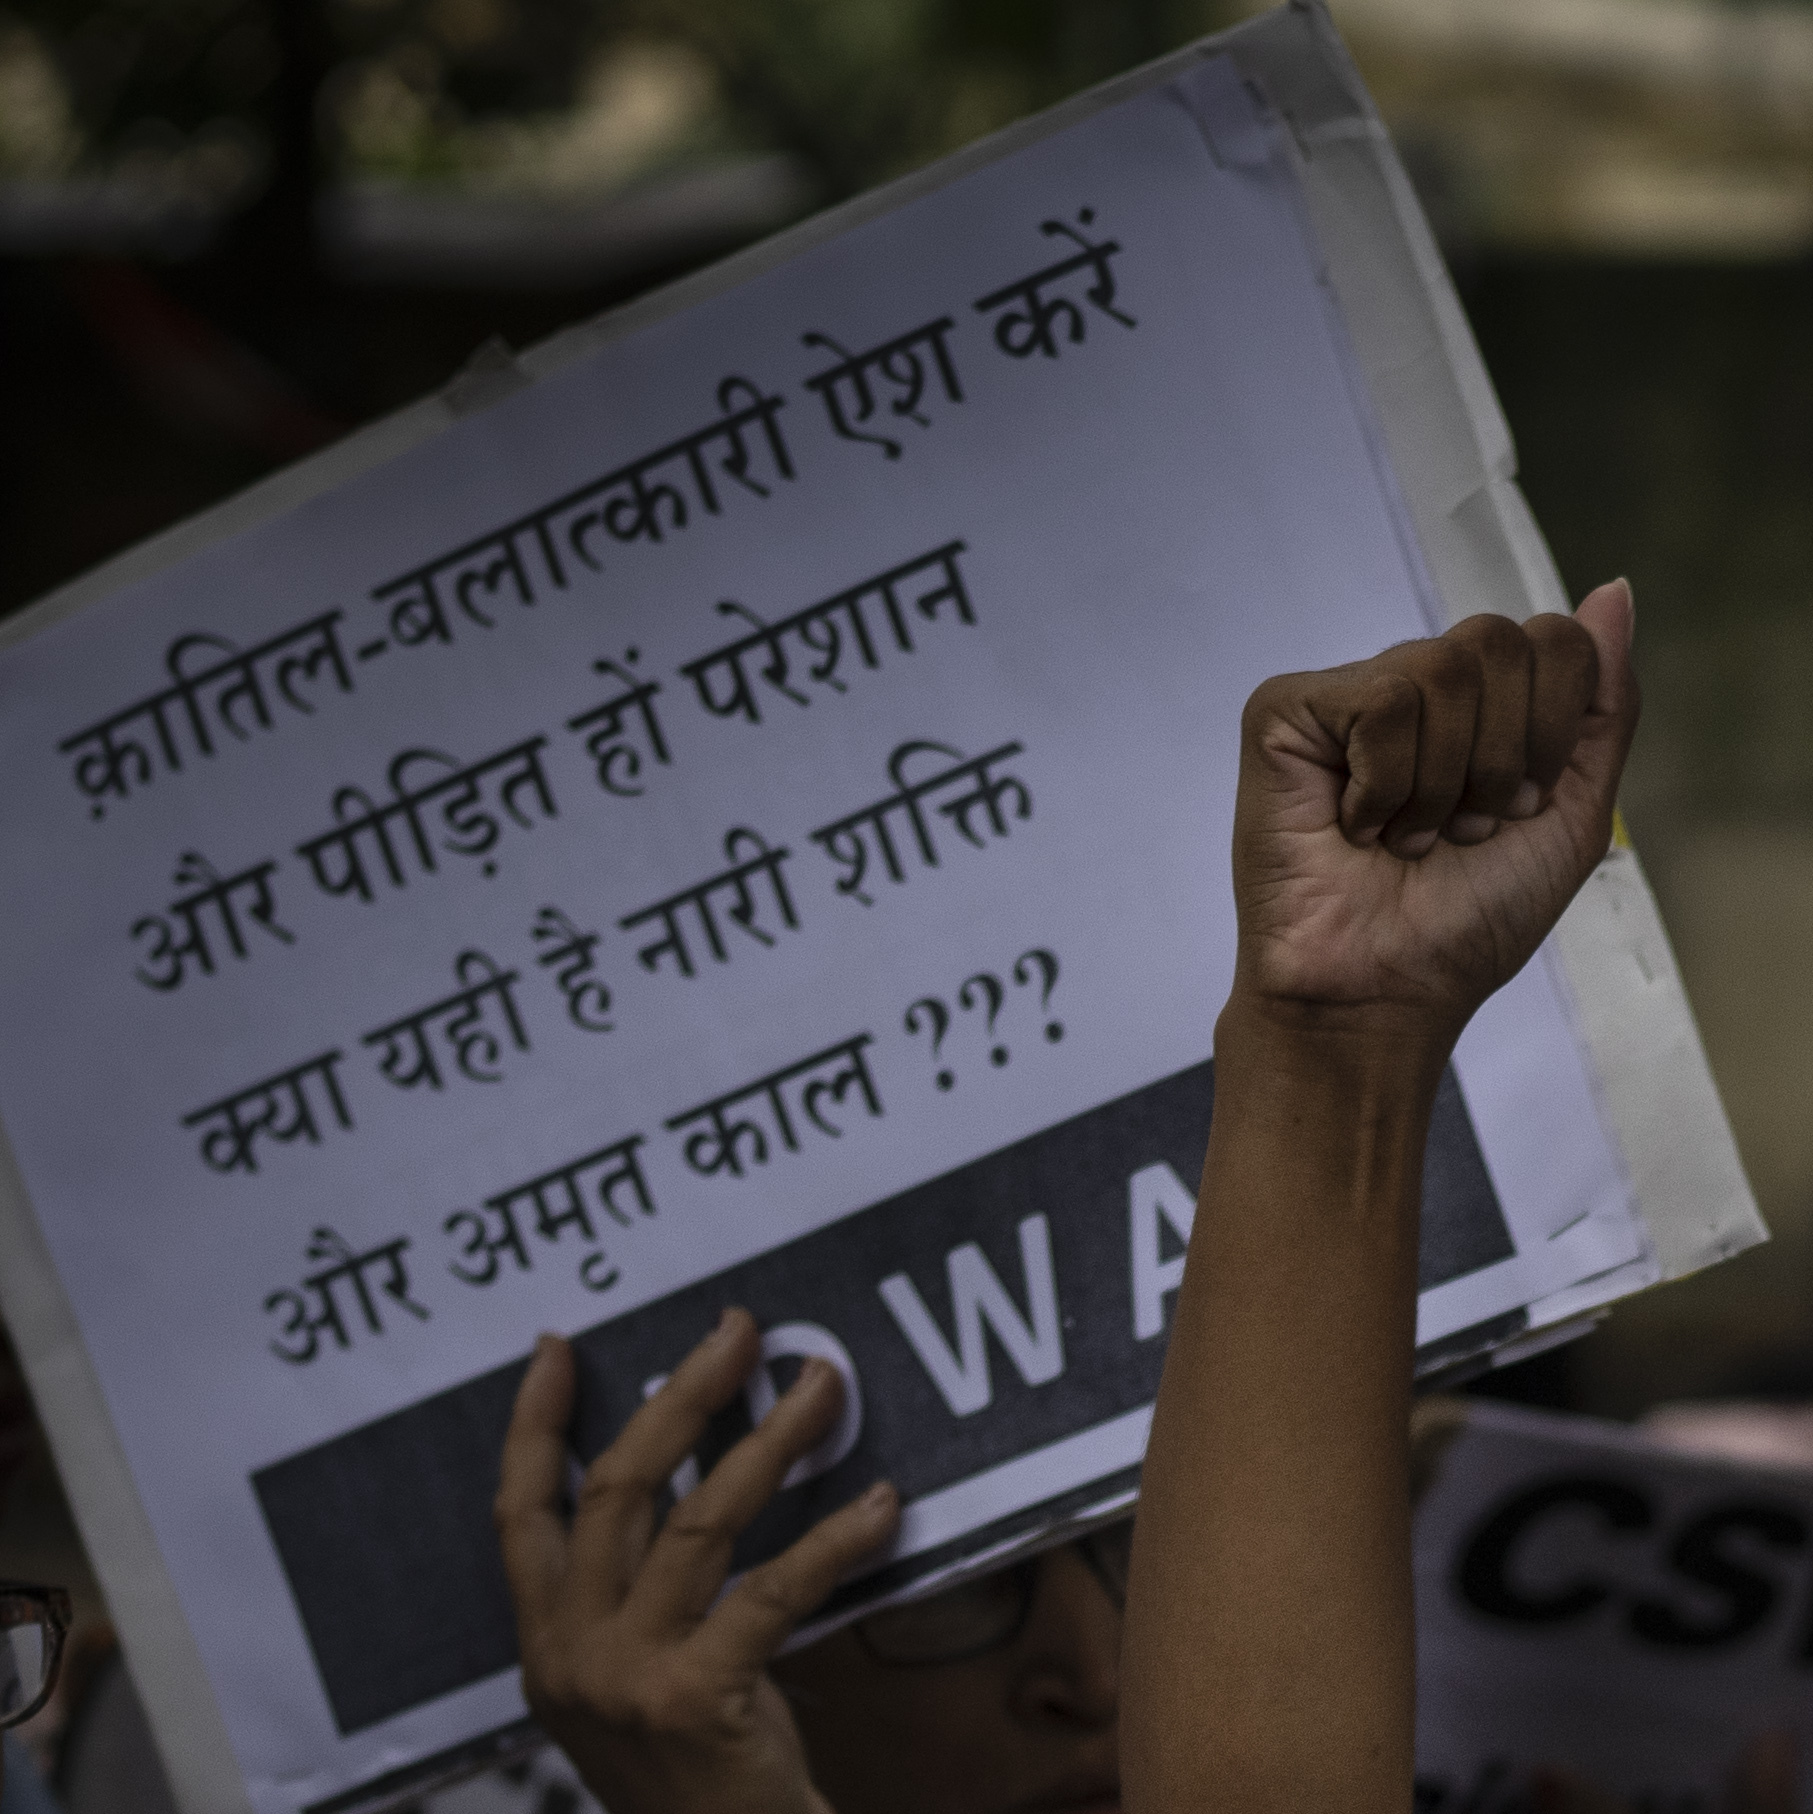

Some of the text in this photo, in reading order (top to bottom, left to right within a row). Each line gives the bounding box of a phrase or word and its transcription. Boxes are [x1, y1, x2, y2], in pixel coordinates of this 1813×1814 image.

[805, 332, 965, 461] ऐश
[977, 207, 1137, 362] करें
[129, 540, 980, 999] और पीड़ित हों परेशान
[183, 740, 1036, 1180] क्या यही है नारी शक्ति
[260, 948, 1064, 1368] और अमृत काल ???
[570, 1160, 1199, 1495] DWA
